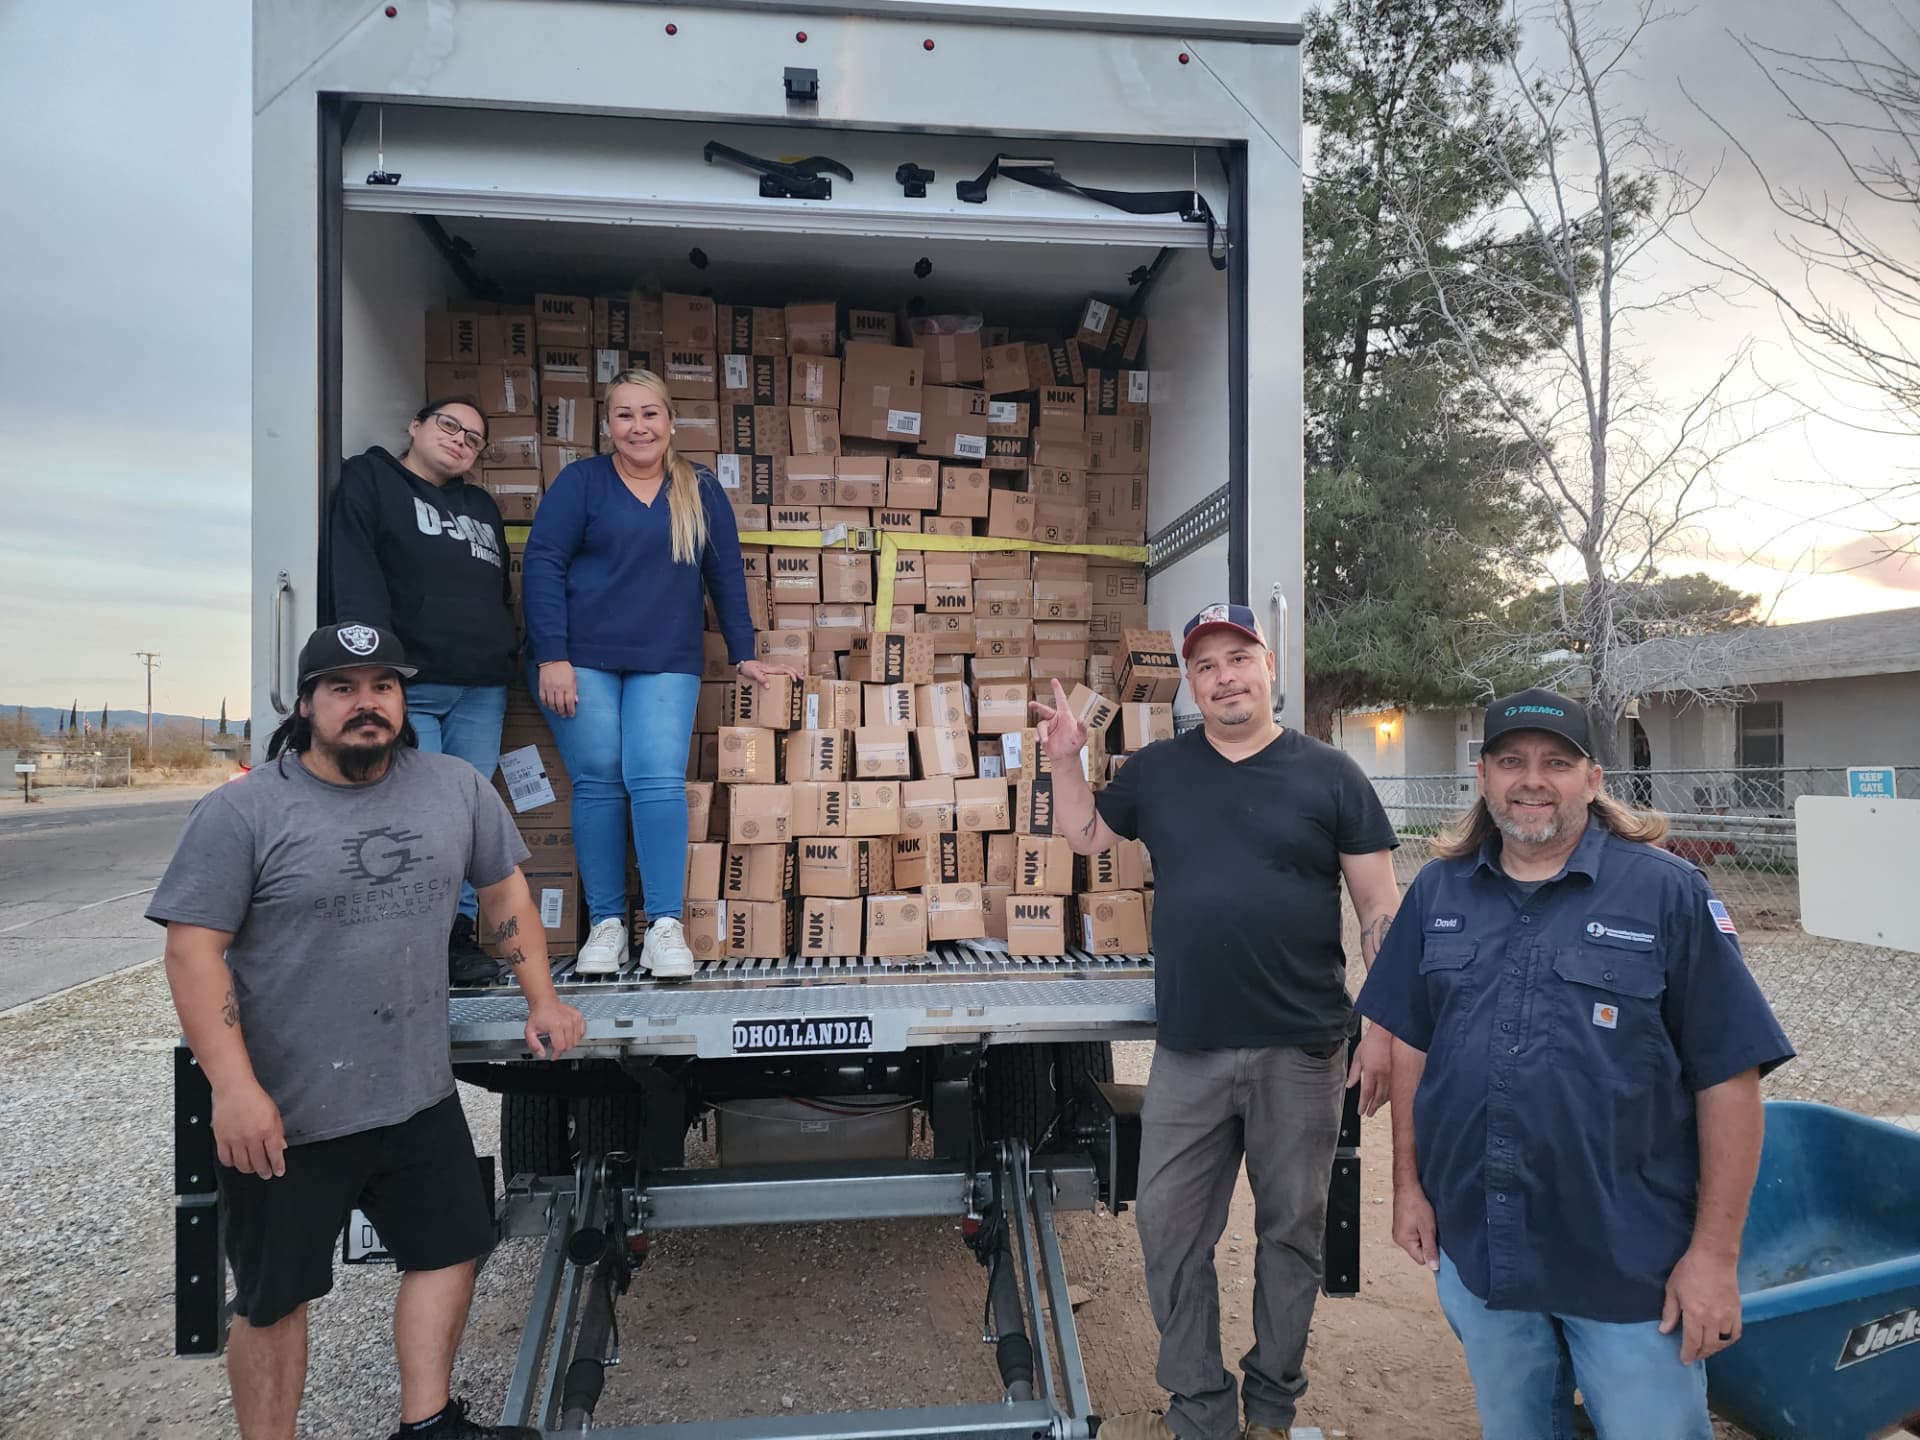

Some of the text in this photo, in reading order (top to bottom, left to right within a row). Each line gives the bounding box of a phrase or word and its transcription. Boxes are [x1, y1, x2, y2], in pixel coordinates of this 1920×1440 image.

[542, 300, 575, 315] NUK
[856, 315, 887, 330] NUK
[458, 319, 473, 353] NUK
[511, 322, 527, 356] NUK
[611, 308, 627, 344] NUK
[736, 314, 750, 348] NUK
[1111, 318, 1132, 348] NUK
[546, 351, 580, 367] NUK
[671, 352, 705, 367] NUK
[1052, 347, 1070, 378] NUK
[757, 364, 772, 397] NUK
[1102, 378, 1116, 408] NUK
[1046, 391, 1076, 404] NUK
[546, 404, 560, 438] NUK
[737, 415, 751, 448] NUK
[992, 439, 1022, 454] NUK
[755, 463, 769, 495] NUK
[778, 511, 810, 524] NUK
[880, 513, 912, 526] NUK
[777, 559, 809, 571] NUK
[896, 560, 915, 572] UK
[936, 595, 967, 608] NUK
[853, 638, 868, 650] NUK
[887, 642, 902, 676] NUK
[1139, 653, 1172, 667] NUK
[740, 684, 753, 720] NUK
[792, 684, 803, 721] NUK
[897, 689, 910, 721] NUK
[1132, 683, 1149, 703] UK
[1518, 705, 1565, 717] TREMCO
[820, 736, 835, 771] NUK
[1859, 772, 1884, 782] KEEP
[1860, 783, 1885, 793] GATE
[826, 791, 840, 827] NUK
[1034, 790, 1050, 826] NUK
[806, 844, 839, 860] NUK
[897, 838, 921, 854] NUK
[943, 838, 957, 879] NUK
[730, 854, 744, 892] NUK
[784, 852, 796, 892] NUK
[860, 851, 869, 890] NUK
[1024, 849, 1040, 886] NUK
[1097, 848, 1113, 883] NUK
[314, 877, 451, 910] GREENTECH
[1015, 904, 1051, 919] NUK
[1434, 918, 1458, 928] David
[732, 912, 747, 949] NUK
[808, 911, 825, 949] NUK
[734, 1022, 873, 1048] DHOLLANDIA
